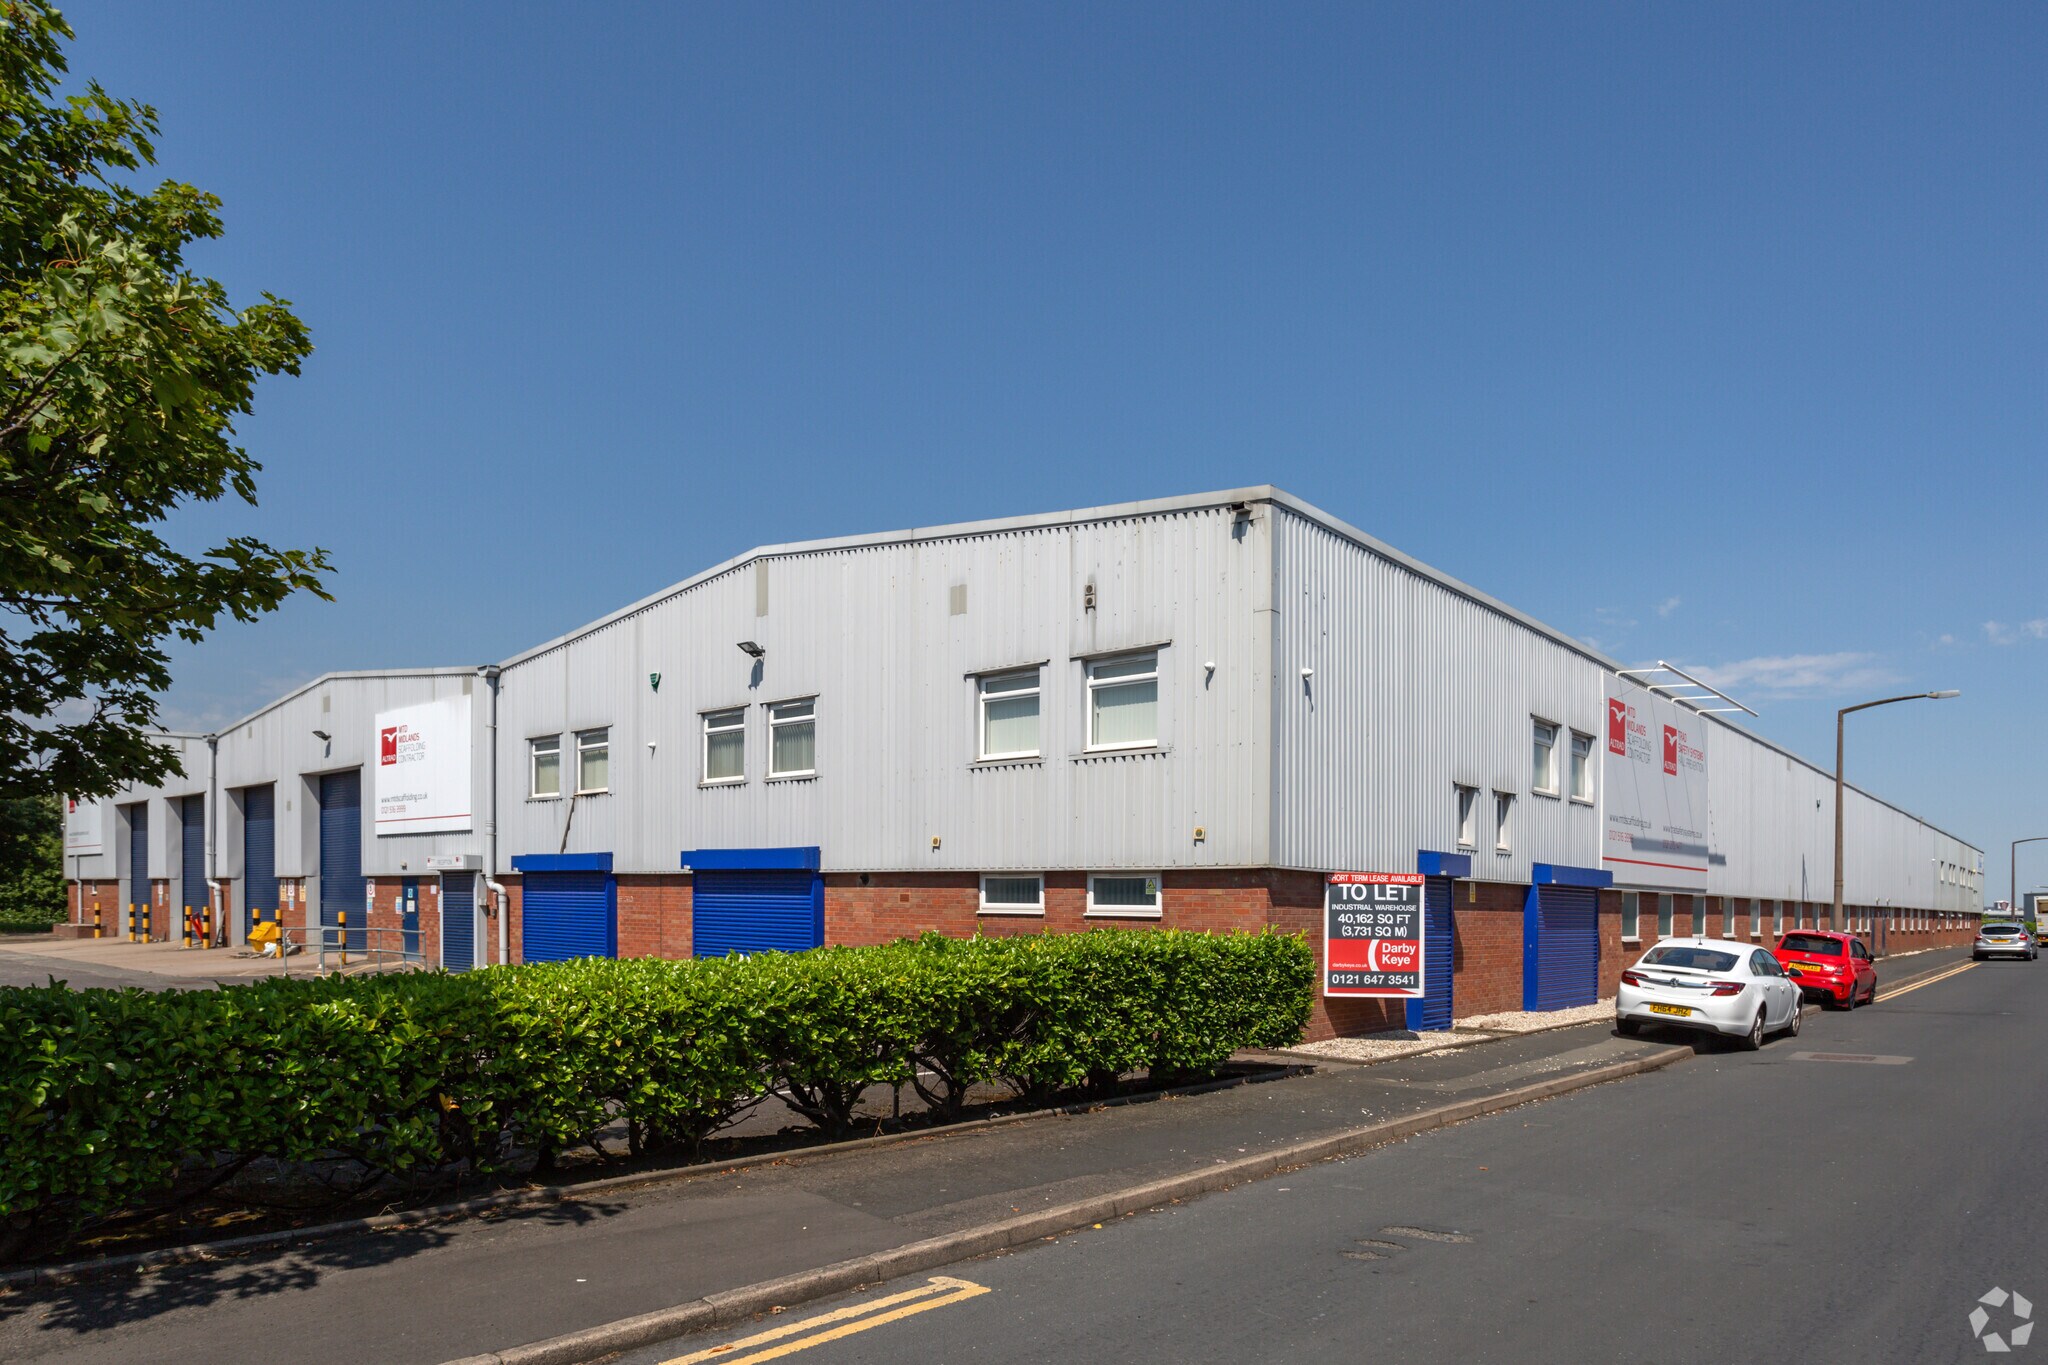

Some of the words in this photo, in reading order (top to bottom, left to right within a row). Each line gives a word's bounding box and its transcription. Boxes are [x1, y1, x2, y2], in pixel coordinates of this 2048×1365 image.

[1627, 720, 1646, 736] MIDLANDS
[398, 733, 420, 743] MIDLANDS
[1627, 732, 1652, 752] SCAFFOLDING
[398, 742, 426, 753] SCAFFOLDING
[1610, 738, 1624, 751] ALTRAD
[398, 752, 425, 764] CONTRACTOR
[1627, 746, 1650, 764] CONTRACTOR
[1338, 884, 1367, 901] TO
[1374, 884, 1411, 901] LET
[1338, 914, 1374, 924] 40,162
[1377, 914, 1393, 924] SQ
[1397, 914, 1411, 924] FT
[1342, 925, 1371, 937] (3,731
[1375, 926, 1391, 937] SQ
[1395, 926, 1407, 937] M)
[1382, 943, 1416, 955] Darby
[1382, 954, 1411, 966] Keye
[1332, 974, 1359, 984] 0121
[1364, 975, 1384, 984] 647
[1388, 976, 1414, 985] 3541
